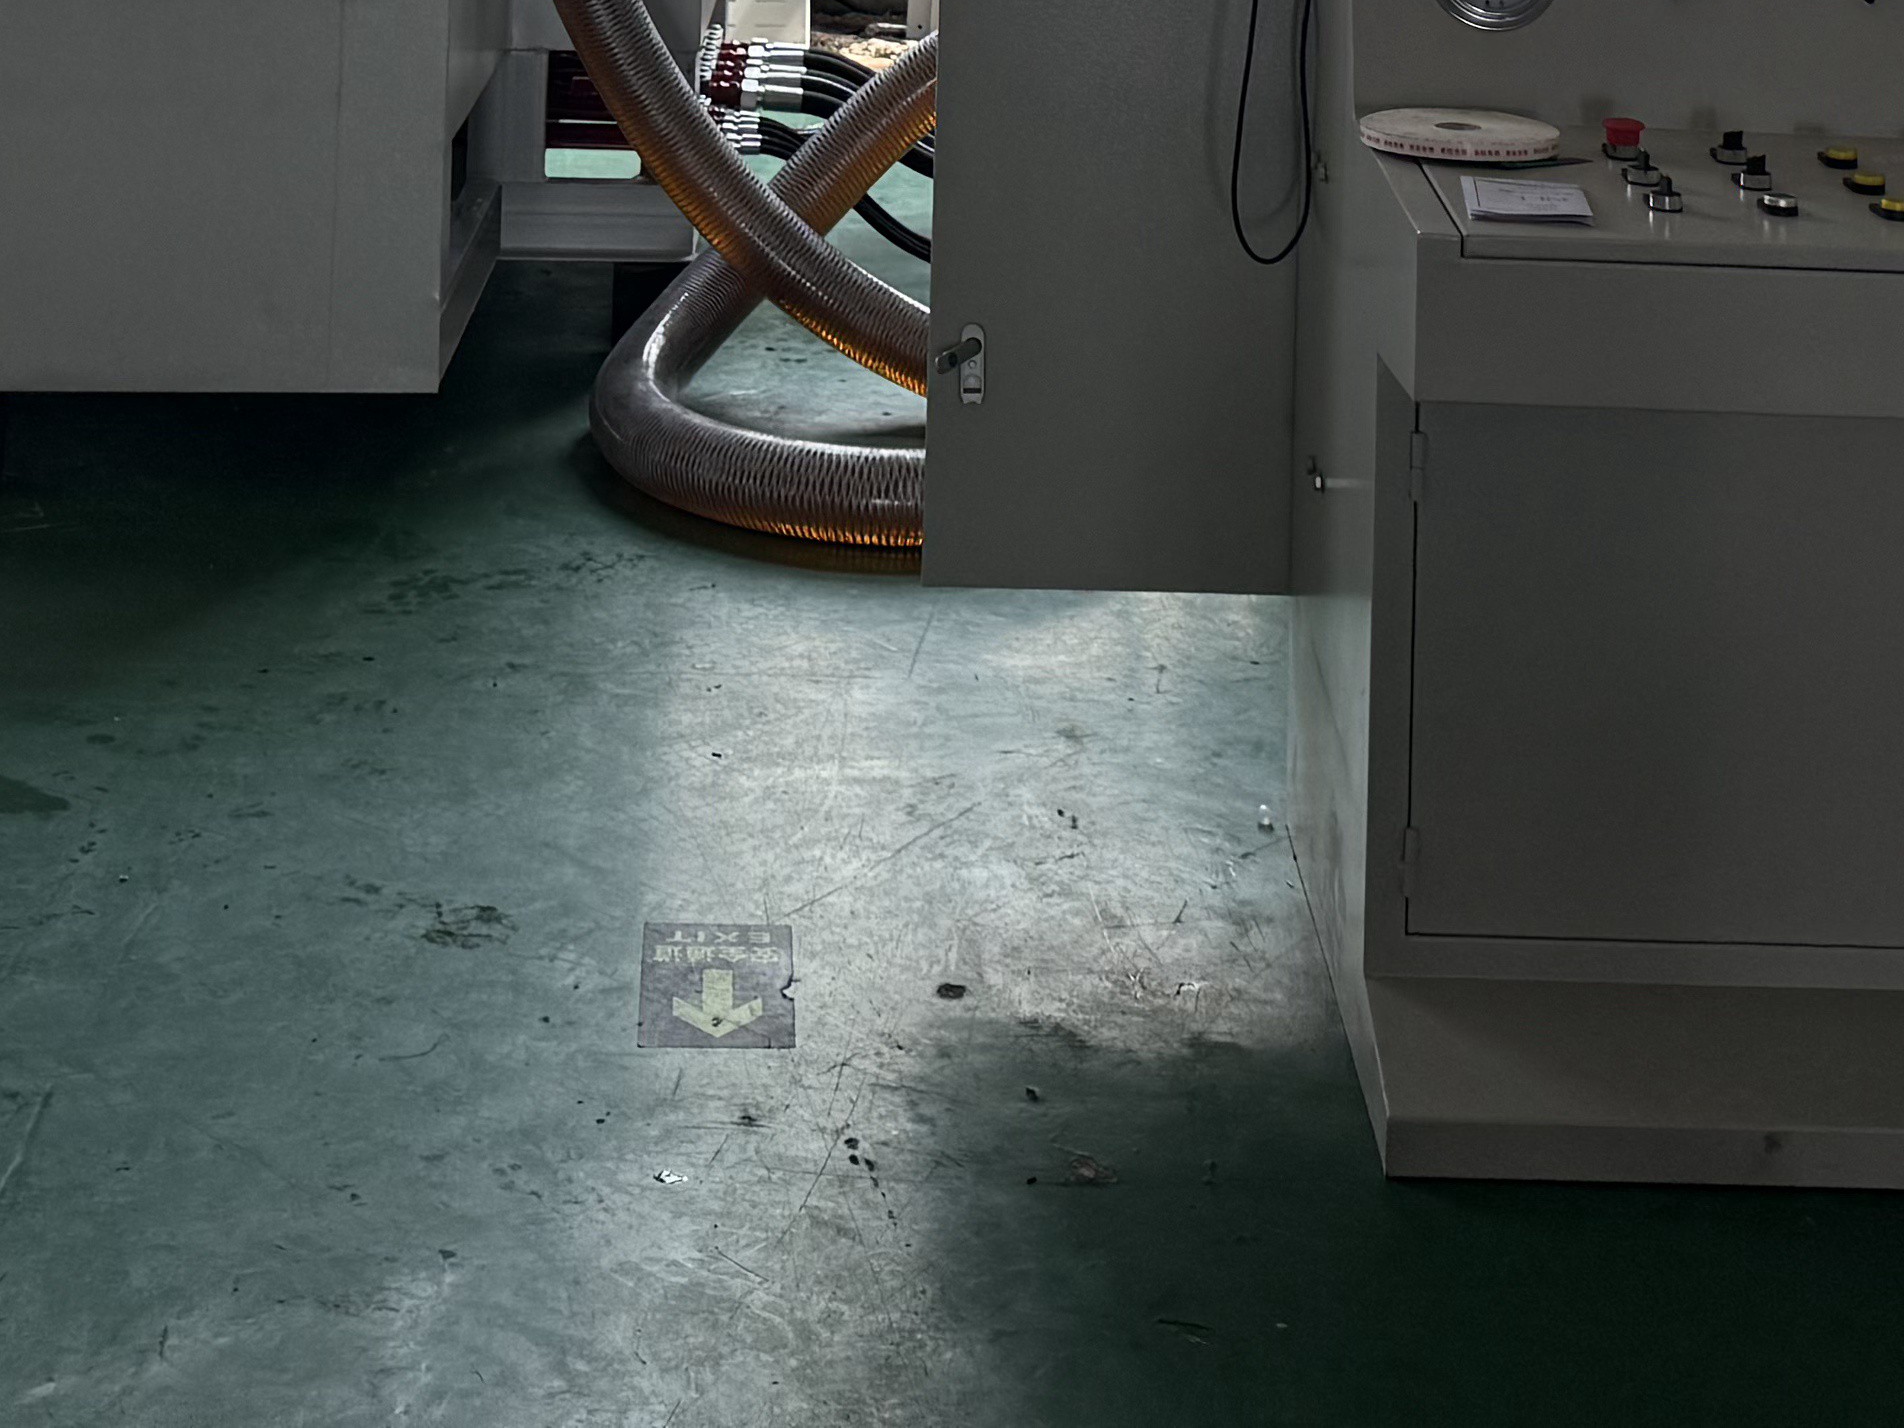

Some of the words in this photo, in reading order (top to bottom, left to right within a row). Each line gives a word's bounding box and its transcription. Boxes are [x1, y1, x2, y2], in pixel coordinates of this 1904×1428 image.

[665, 930, 771, 943] EXIT
[652, 944, 781, 964] 安全通道
